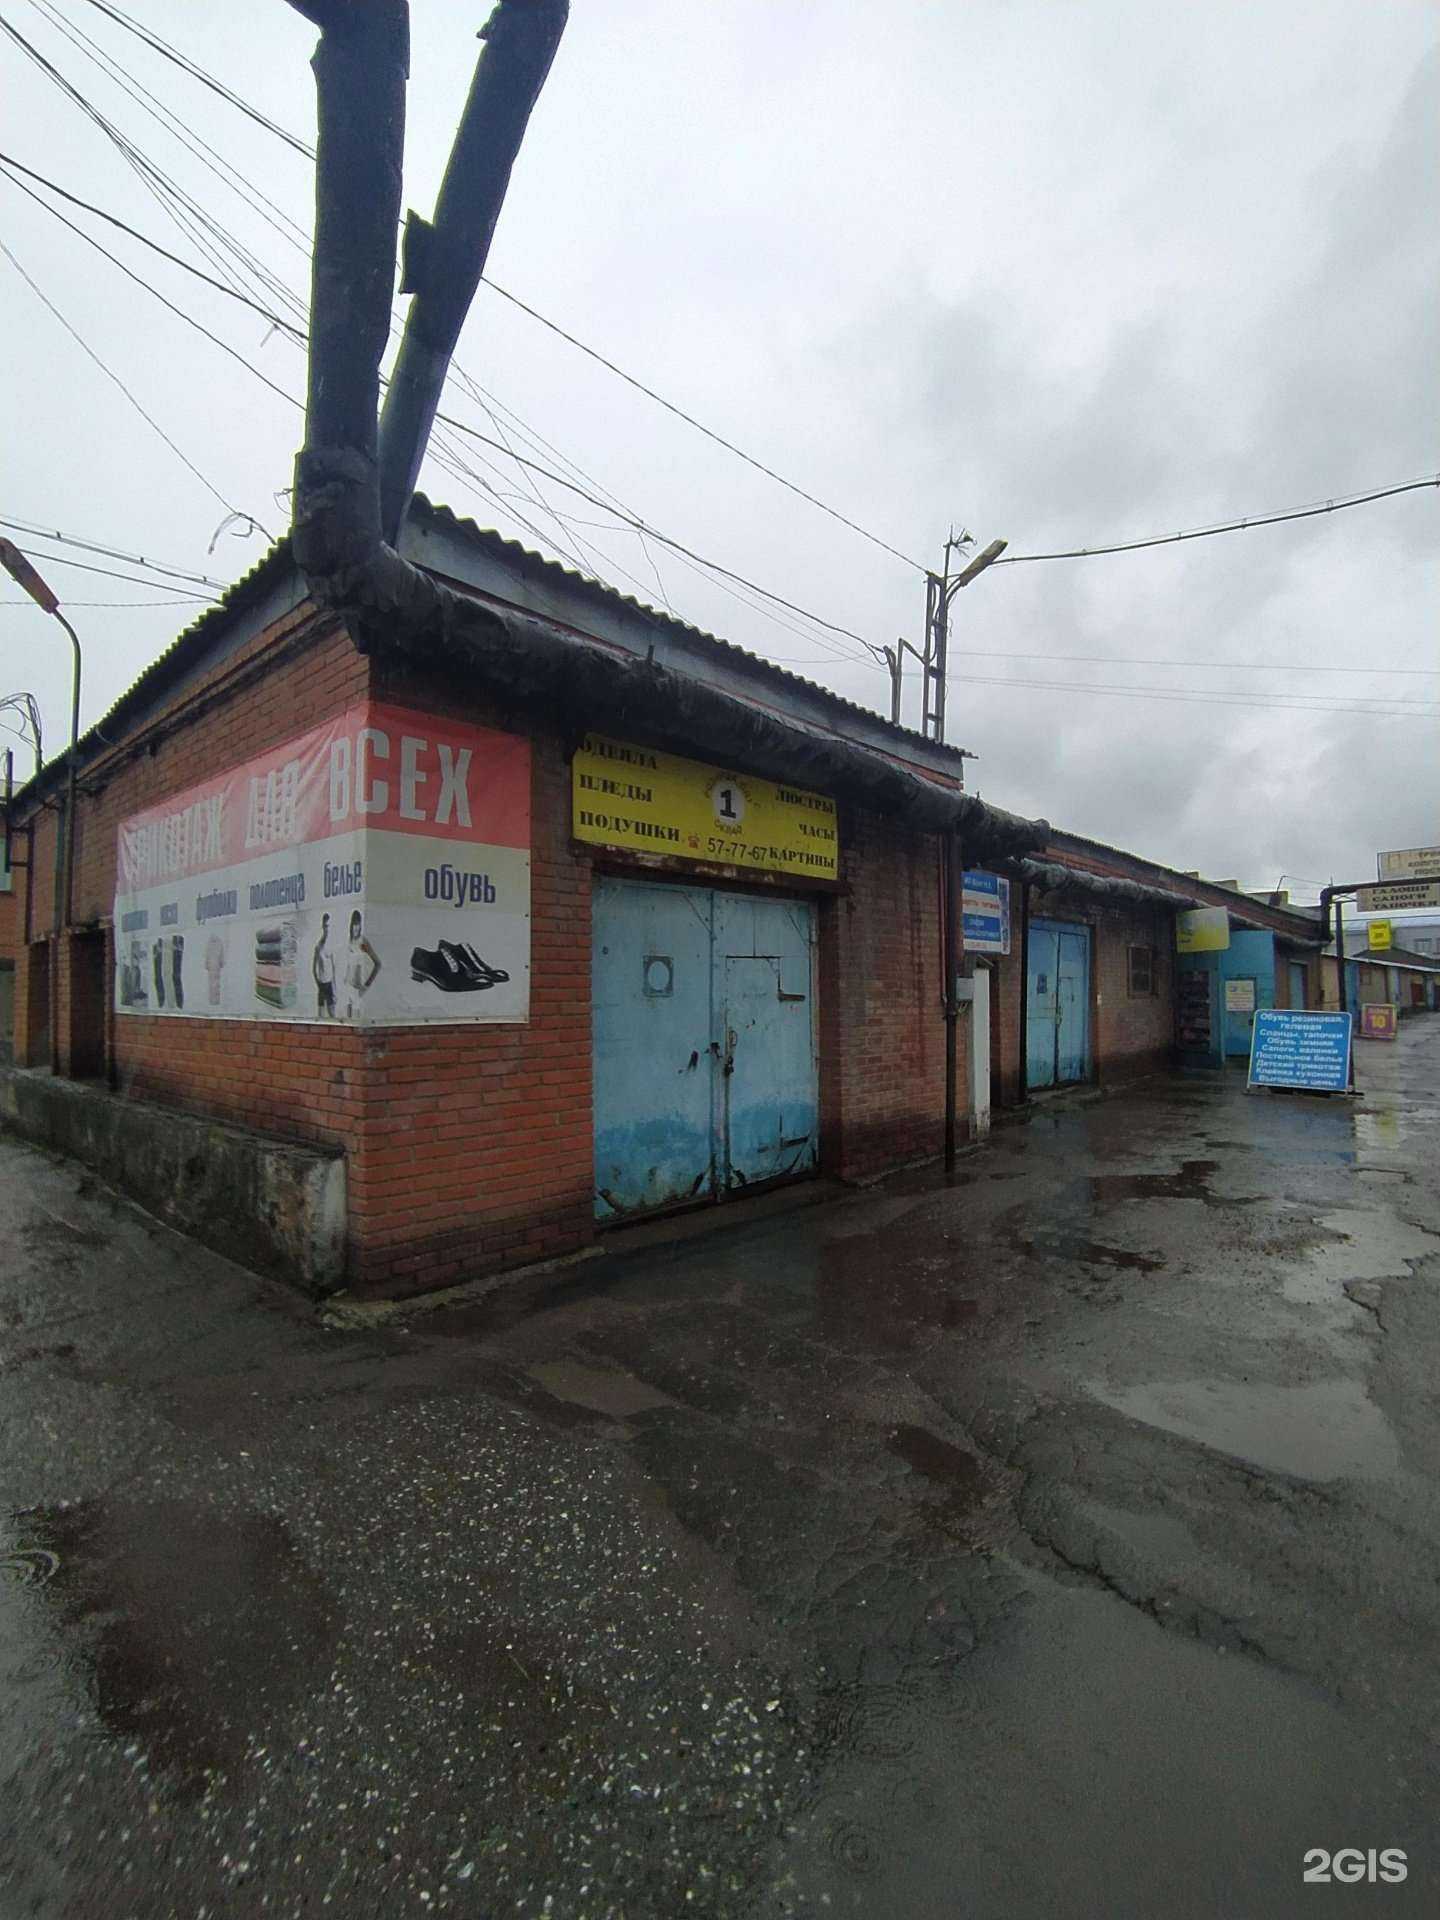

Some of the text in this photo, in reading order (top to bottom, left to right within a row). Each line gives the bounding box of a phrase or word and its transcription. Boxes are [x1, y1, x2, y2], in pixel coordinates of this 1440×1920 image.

[329, 728, 473, 828] ВСЕХ
[579, 774, 653, 802] ПЛЕДЫ
[720, 789, 737, 819] 1
[775, 789, 834, 814] ЛЮСТРЫ
[579, 811, 681, 841] ПОДУШКИ
[798, 823, 836, 841] ЧАСЫ
[707, 837, 768, 861] 57-77-67
[767, 847, 835, 869] КАРТИНЫ
[323, 861, 362, 898] белье
[425, 864, 497, 908] обувь
[1372, 893, 1427, 903] САПОГИ
[1373, 900, 1438, 910] ТАПОЧКИ
[1260, 1012, 1291, 1022] Обувь
[1266, 1037, 1297, 1046] Обувь
